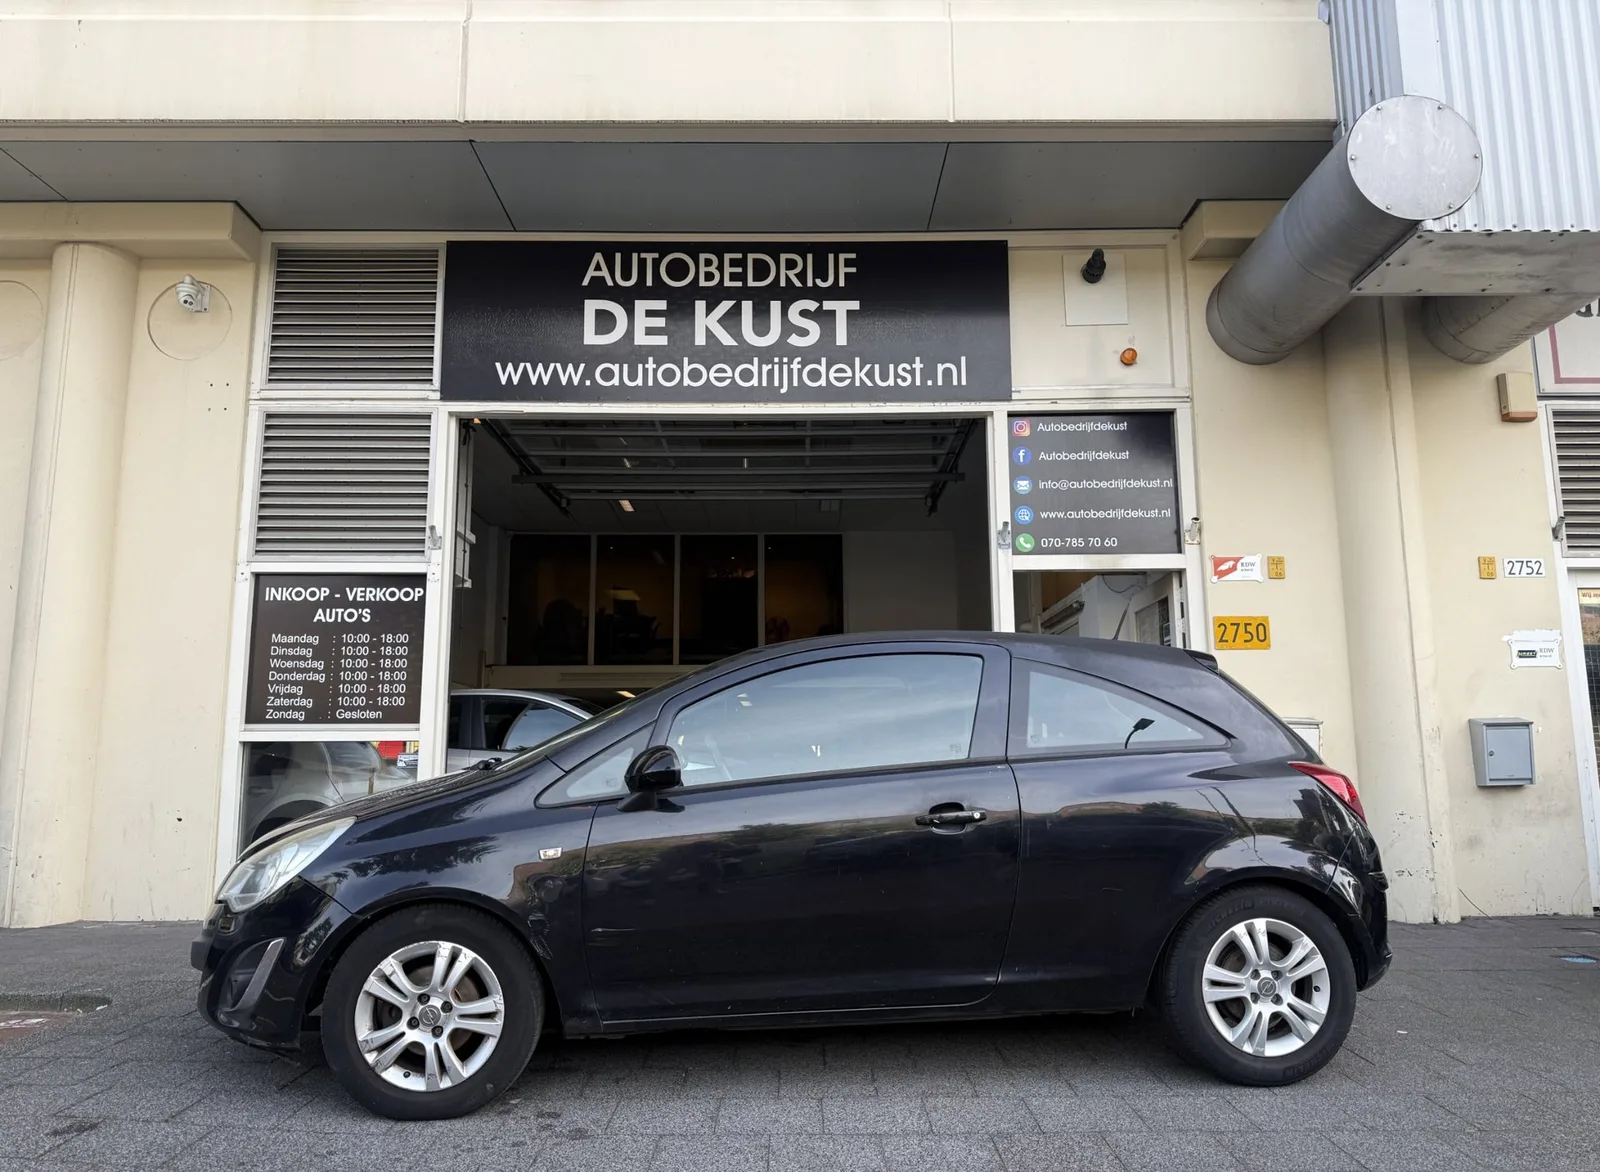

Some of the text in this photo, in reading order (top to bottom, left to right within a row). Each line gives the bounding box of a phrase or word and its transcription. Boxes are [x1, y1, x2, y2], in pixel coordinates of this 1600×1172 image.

[582, 252, 857, 288] AUTOBEDRIJF
[583, 299, 861, 347] DE KUST
[495, 355, 967, 394] www.autobedrijfdekust.nl
[1037, 421, 1128, 433] Autobedrijfdekust
[1038, 450, 1130, 462] Autobedrijfdekust
[1040, 508, 1171, 520] www.autobedrijfdekust.nl
[1041, 537, 1118, 548] 070-785 70 60
[1507, 560, 1543, 575] 2752
[265, 587, 330, 602] INKOOP
[346, 587, 424, 602] VERKOOP
[313, 608, 371, 623] AUTO'S
[1217, 622, 1267, 643] 2750
[272, 634, 319, 644] Maandag
[341, 634, 370, 643] 10:00
[381, 634, 409, 643] 18:00
[271, 647, 312, 657] Dinsdag
[341, 646, 369, 655] 10:00
[380, 646, 408, 655] 18:00
[270, 659, 324, 669] Woensdag
[340, 659, 368, 668] 10:00
[379, 659, 407, 668] 18:00
[269, 672, 325, 682] Donderdag
[339, 671, 367, 680] 10:00
[378, 671, 407, 680] 18:00
[268, 684, 303, 695] Vrijdag
[338, 684, 366, 693] 10:00
[378, 684, 406, 693] 18:00
[267, 697, 312, 707] Zaterdag
[337, 696, 366, 706] 10:00
[377, 696, 405, 706] 18:00
[266, 710, 305, 720] Zondag
[336, 709, 382, 719] Gesloten
